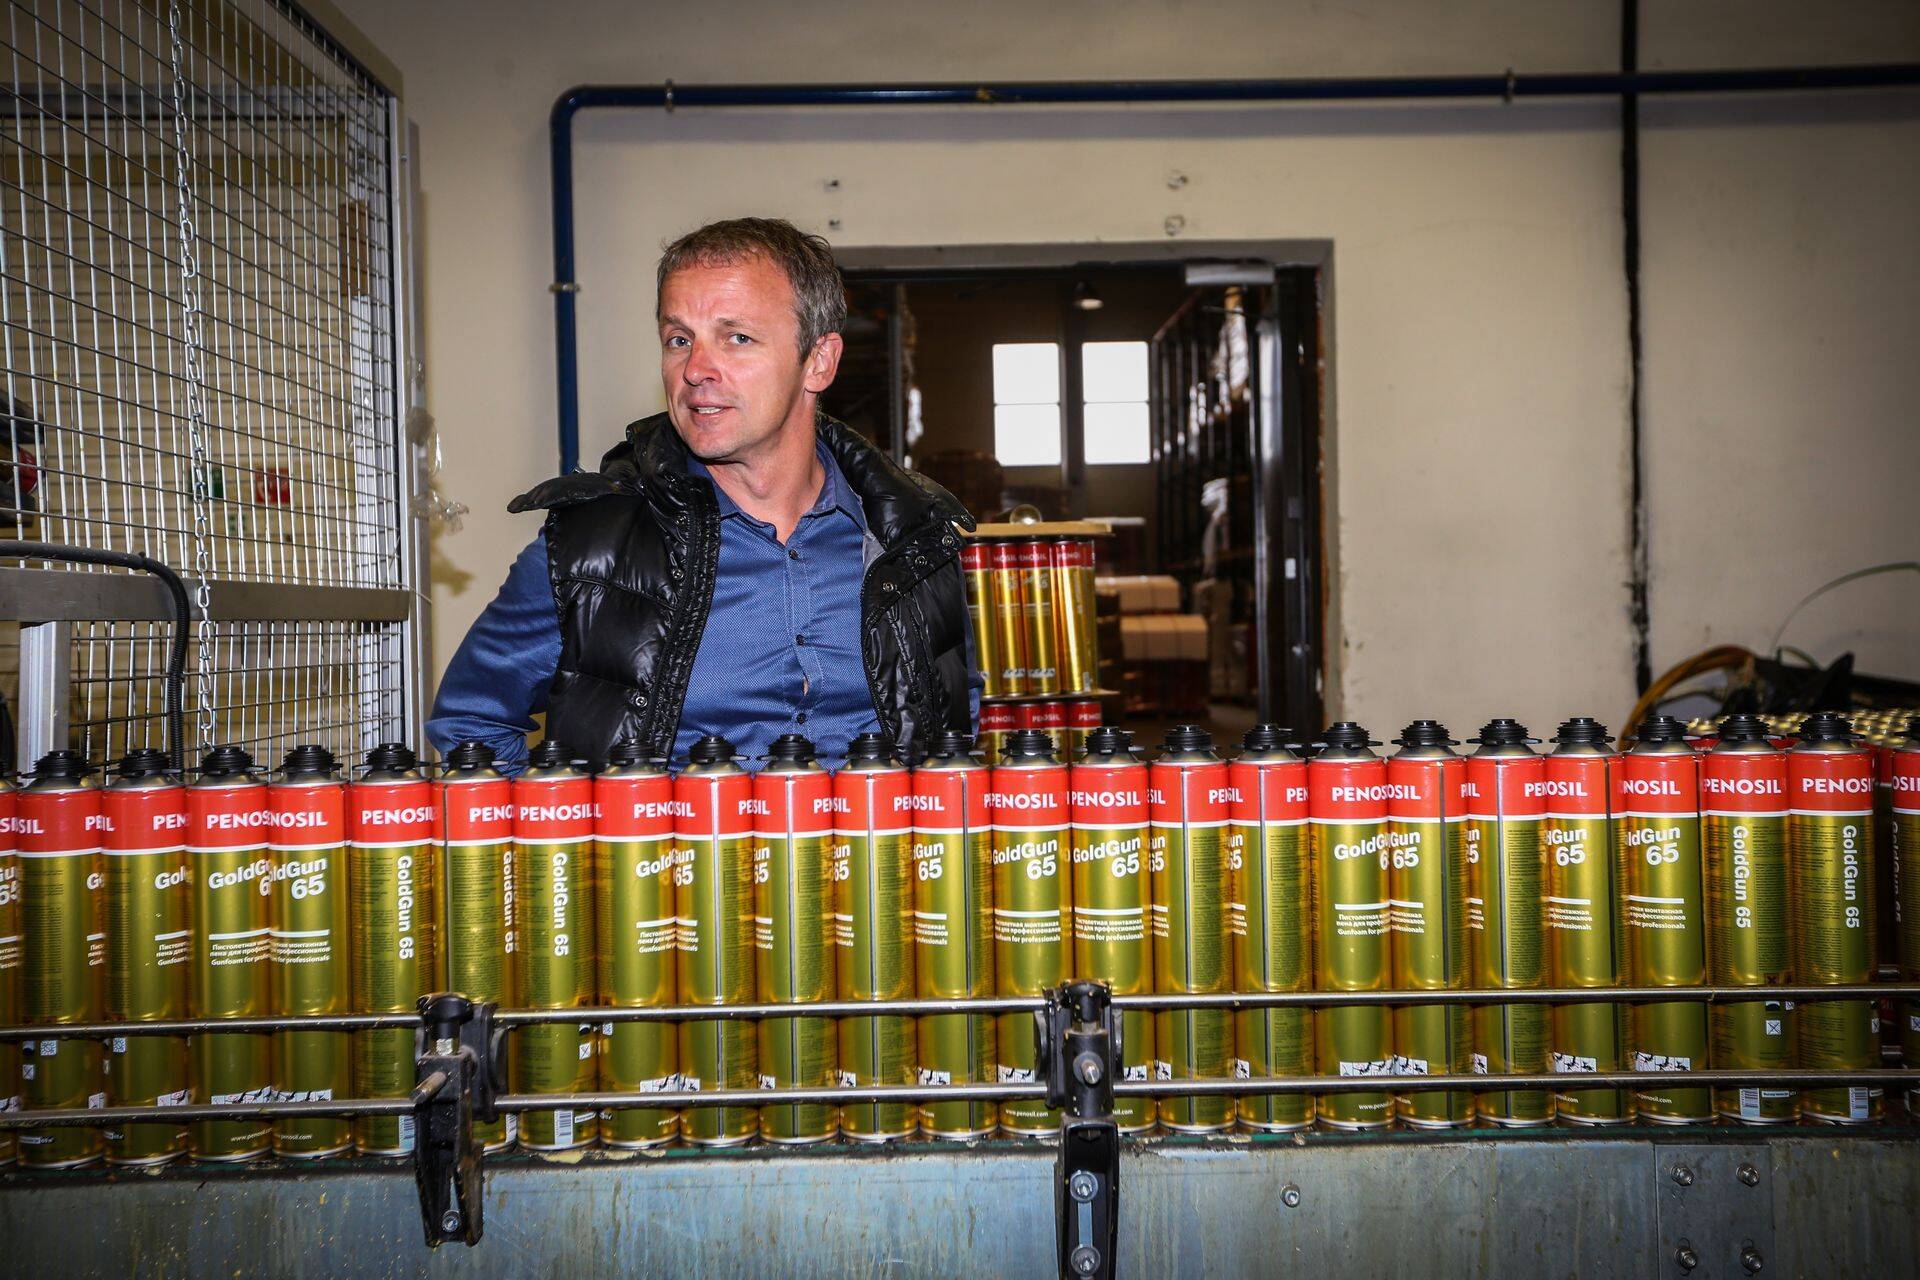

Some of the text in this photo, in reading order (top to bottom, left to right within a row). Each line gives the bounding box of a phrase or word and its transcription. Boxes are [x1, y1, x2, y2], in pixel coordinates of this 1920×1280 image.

[1331, 785, 1387, 802] PENOS
[1387, 784, 1421, 800] OSIL
[1547, 781, 1588, 797] OSIL
[1623, 780, 1681, 795] NOSIL
[1704, 778, 1781, 794] PENOSIL
[991, 793, 1058, 809] PENOSIL
[1072, 791, 1141, 807] PENOSIL
[206, 810, 270, 829] PENOS
[270, 811, 328, 828] NOSIL
[469, 804, 513, 822] PENO
[520, 803, 593, 822] PENOSIL
[1333, 832, 1388, 860] GoldG
[1627, 827, 1681, 846] ldGun
[992, 839, 1058, 866] GoldGun
[1073, 836, 1141, 864] GoldGun
[1393, 846, 1419, 869] 65
[1556, 843, 1586, 867] 65
[1646, 843, 1679, 866] 65
[208, 859, 269, 889] GoldG
[271, 857, 328, 883] ldGun
[675, 864, 694, 887] 65
[918, 858, 943, 881] 65
[1026, 854, 1057, 880] 65
[1111, 853, 1140, 878] 65
[1733, 825, 1752, 928] GoldGun 65
[1843, 825, 1860, 929] GoldGun 65
[290, 873, 326, 900] 65
[397, 855, 415, 960] GoldGun 65
[552, 852, 569, 957] GoldGun 65
